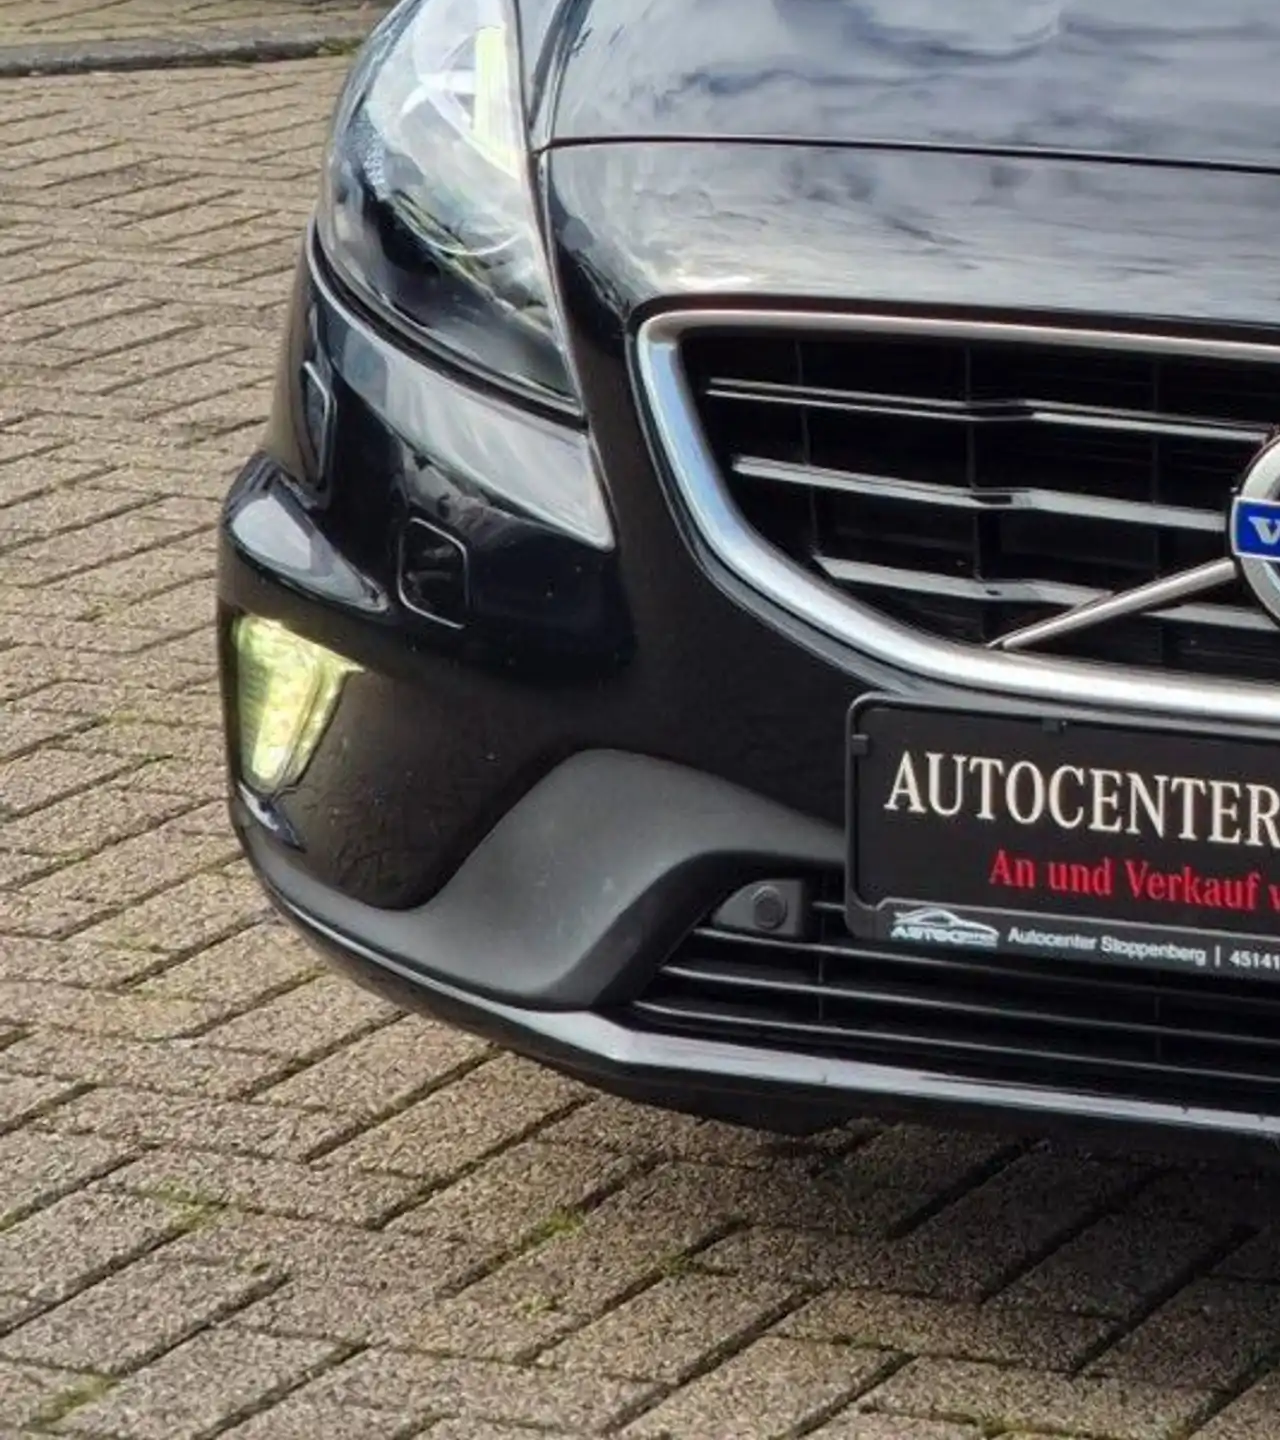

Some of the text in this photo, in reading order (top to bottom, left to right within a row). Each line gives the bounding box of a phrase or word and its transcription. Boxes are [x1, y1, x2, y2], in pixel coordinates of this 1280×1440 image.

[988, 849, 1037, 891] An
[1047, 857, 1113, 897] und
[1125, 859, 1262, 907] Verkauf
[1008, 926, 1098, 950] Autocenter
[1101, 935, 1206, 966] Stoppenberg
[1229, 949, 1280, 970] 45141
